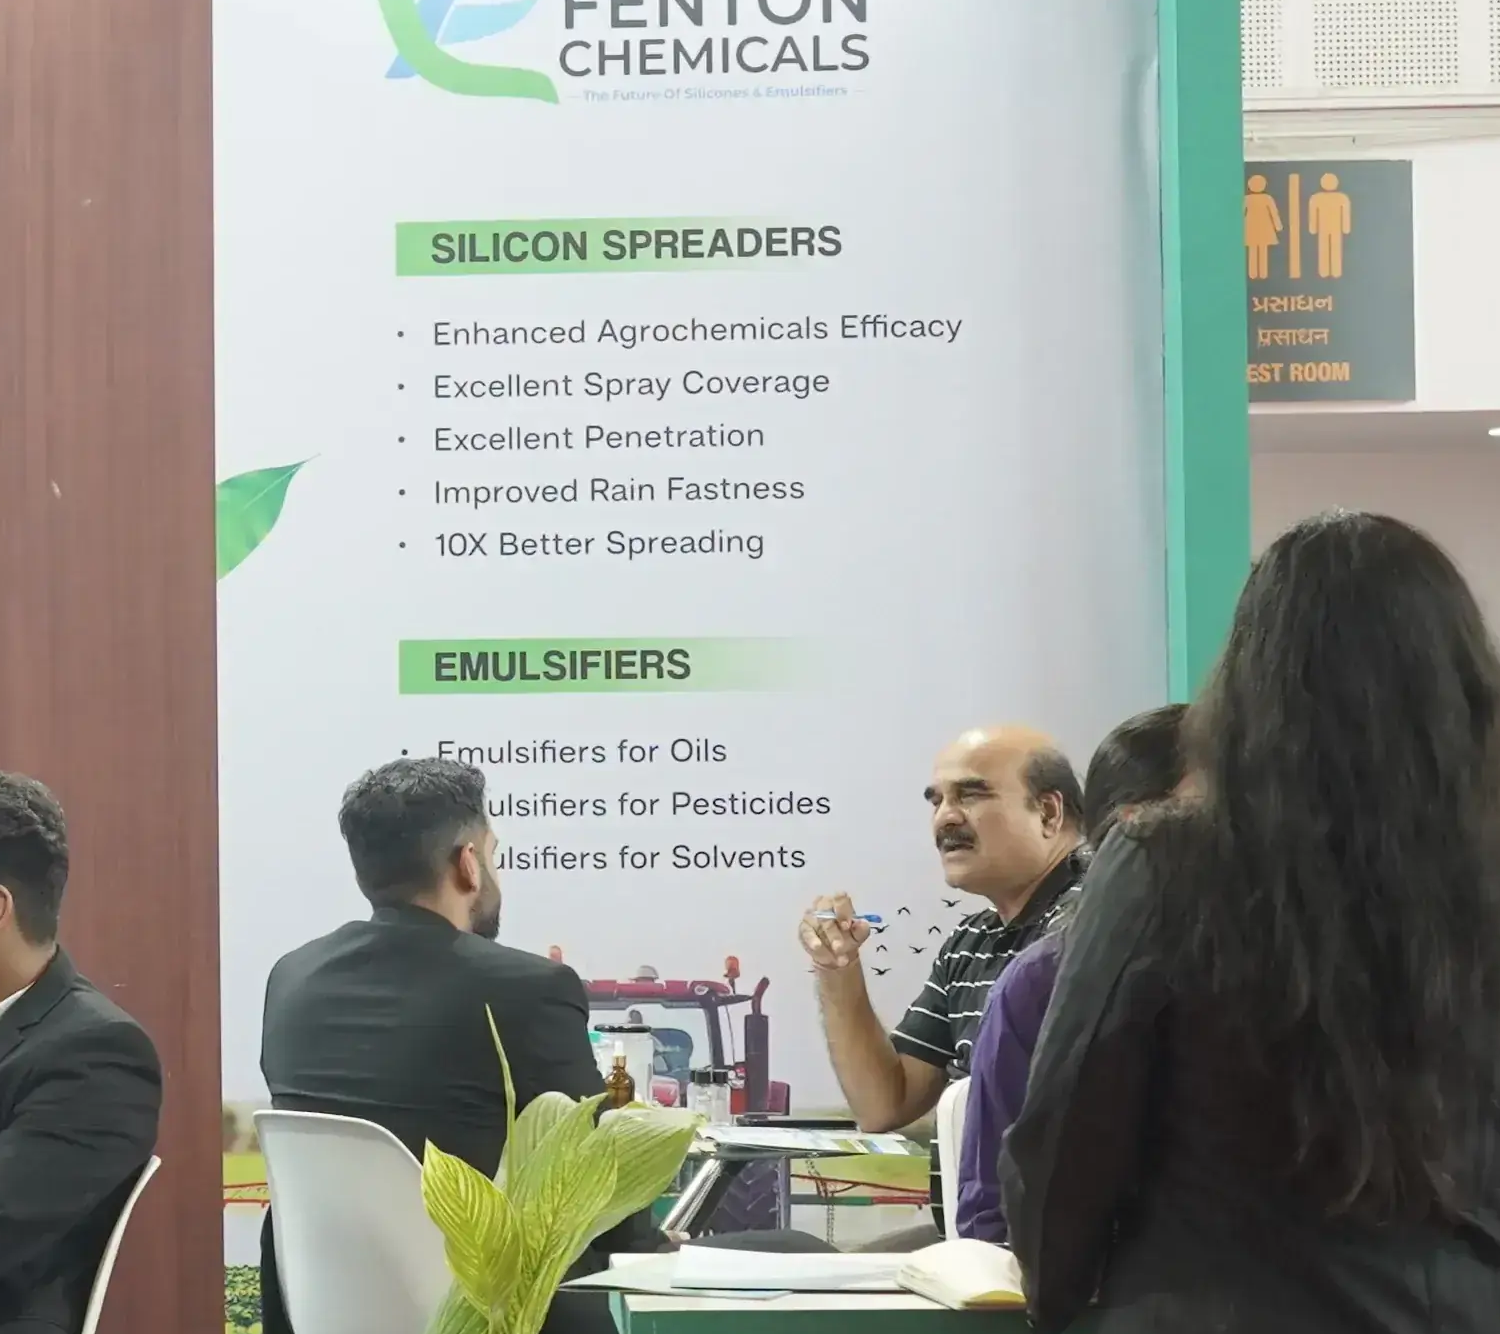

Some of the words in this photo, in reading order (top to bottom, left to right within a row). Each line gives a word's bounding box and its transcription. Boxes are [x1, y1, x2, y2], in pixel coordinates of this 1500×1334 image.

[559, 34, 870, 76] CHEMICALS
[584, 90, 608, 102] The
[613, 89, 662, 101] Future
[664, 88, 680, 99] Of
[685, 87, 749, 99] Silicones
[766, 85, 848, 97] Emulsifiers
[431, 231, 588, 264] SILICON
[603, 226, 843, 260] SPREADERS
[435, 321, 585, 346] Enhanced
[597, 316, 829, 349] Agrochemicals
[841, 314, 963, 343] Efficacy
[435, 373, 573, 398] Excellent
[584, 372, 672, 402] Spray
[683, 370, 830, 398] Coverage
[1247, 362, 1284, 383] EST
[1290, 361, 1350, 382] ROOM
[435, 426, 573, 451] Excellent
[585, 423, 765, 449] Penetration
[435, 479, 578, 509] Improved
[590, 477, 655, 502] Rain
[667, 475, 805, 501] Fastness
[436, 533, 488, 557] 10X
[500, 532, 595, 556] Better
[607, 529, 765, 560] Spreading
[435, 648, 691, 682] EMULSIFIERS
[438, 739, 606, 764] Emulsifiers
[618, 738, 659, 763] for
[670, 736, 728, 763] Oils
[489, 792, 606, 817] ulsifiers
[619, 791, 660, 816] for
[672, 790, 831, 816] Pesticides
[496, 845, 607, 870] ulsifiers
[620, 845, 660, 869] for
[672, 843, 806, 869] Solvents
